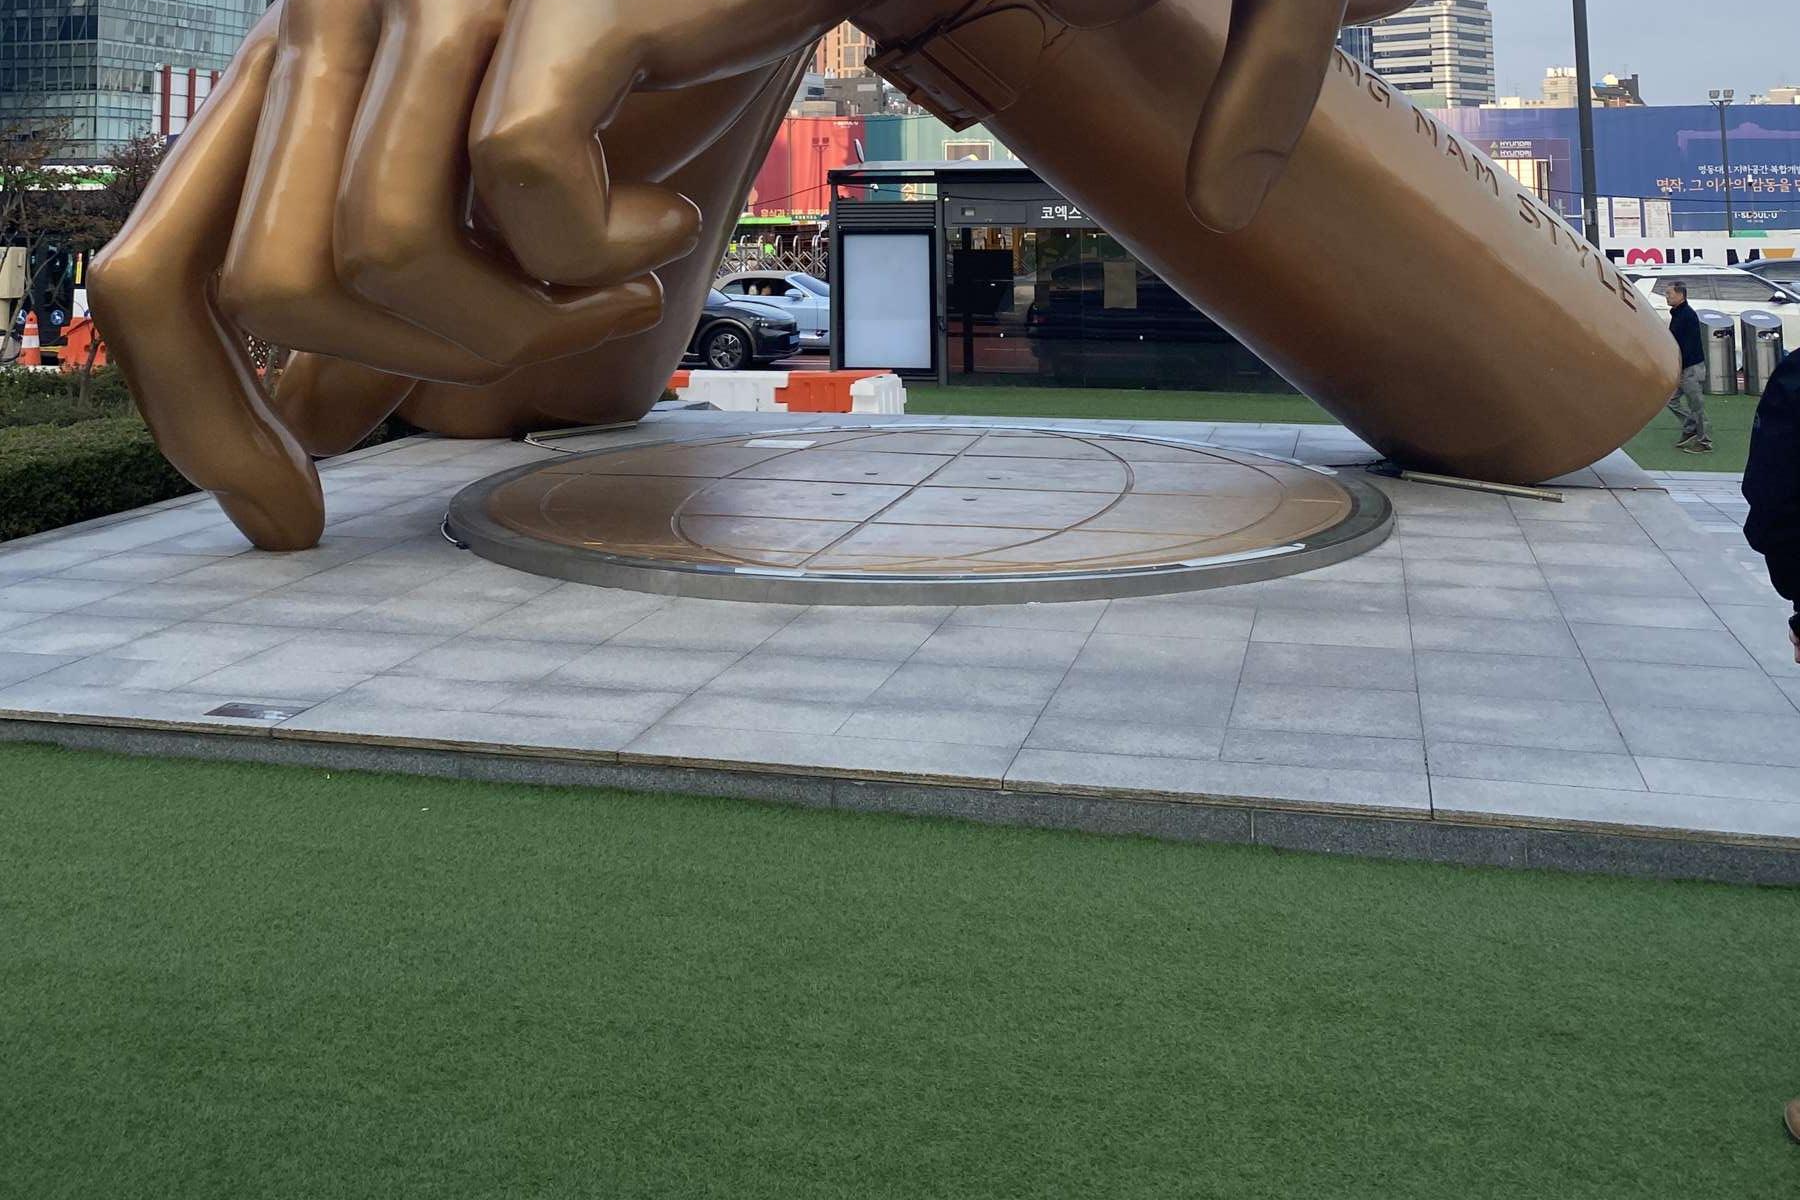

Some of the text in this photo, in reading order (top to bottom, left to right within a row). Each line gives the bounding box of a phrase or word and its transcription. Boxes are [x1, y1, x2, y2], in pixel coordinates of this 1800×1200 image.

[1689, 179, 1704, 191] 그
[1040, 205, 1083, 221] 코엑스
[1411, 104, 1499, 196] NAM
[1516, 193, 1637, 312] STYLE
